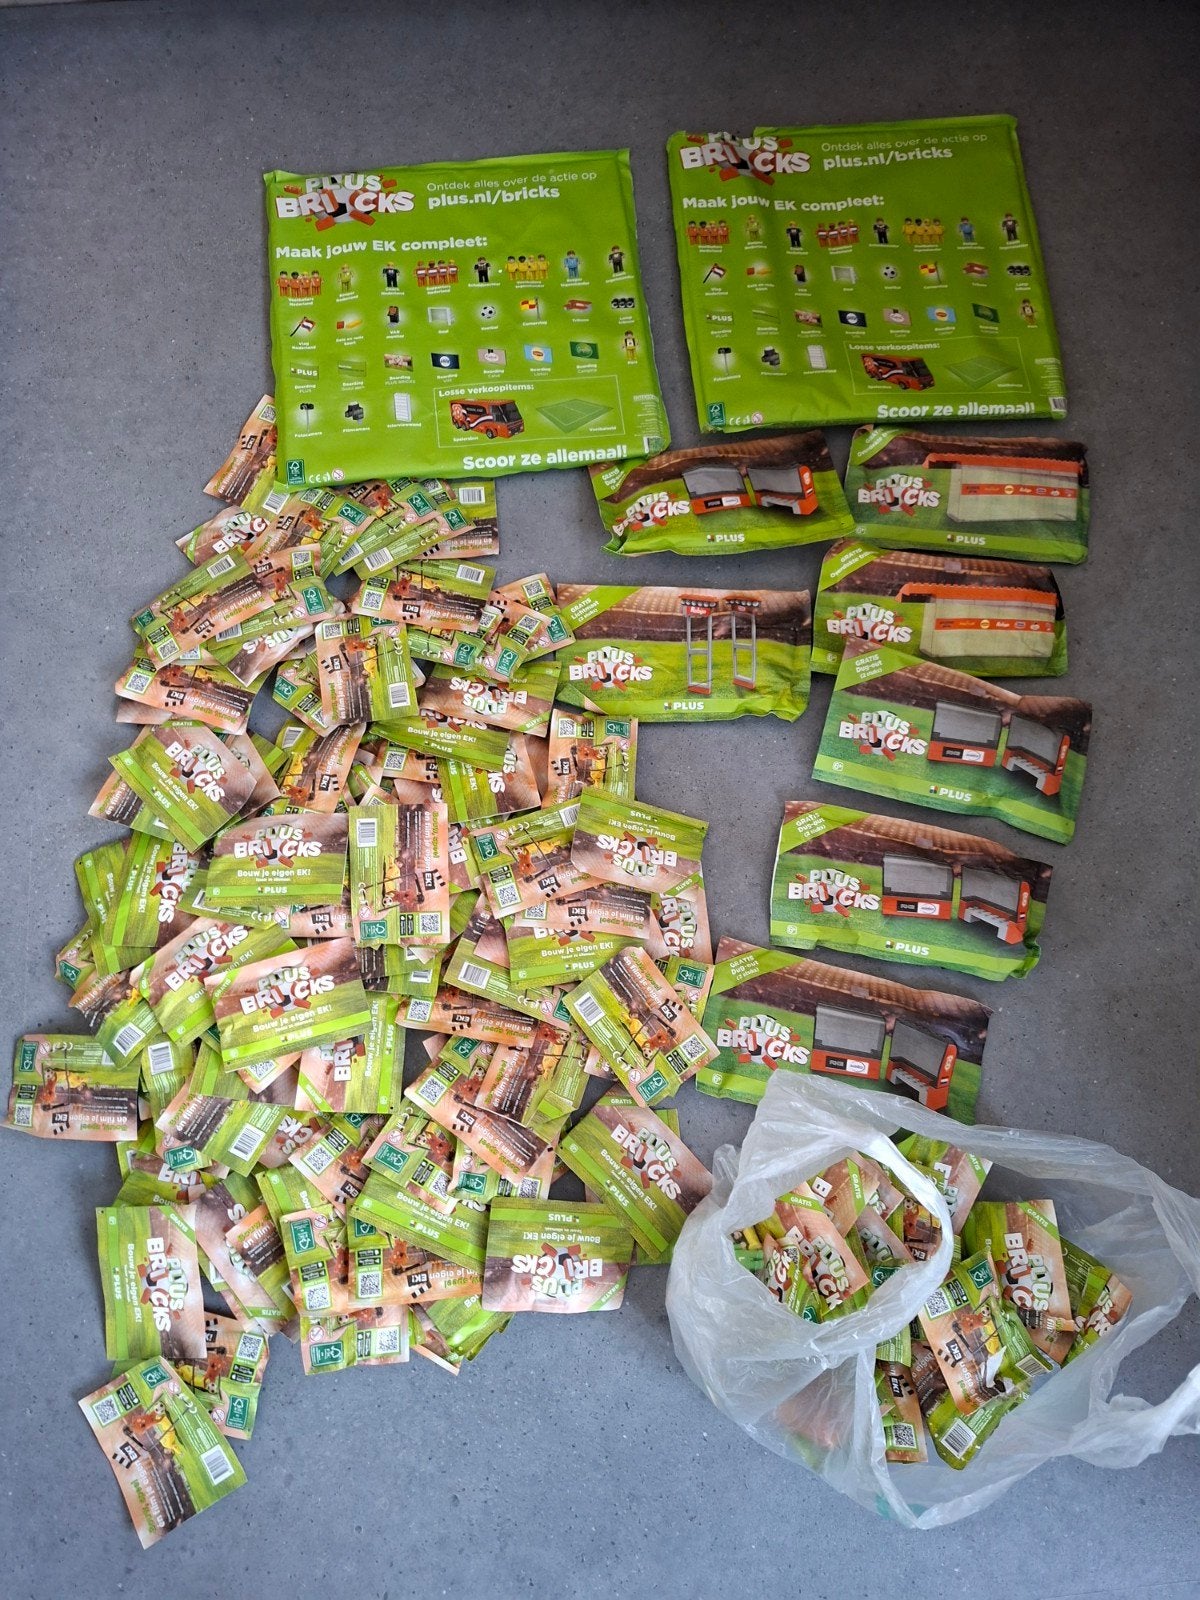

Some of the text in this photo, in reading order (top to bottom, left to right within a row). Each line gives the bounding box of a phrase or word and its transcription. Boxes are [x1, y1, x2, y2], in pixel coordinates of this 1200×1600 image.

[822, 134, 988, 152] Ontdek alles over de actie op
[680, 142, 810, 173] BRICKS
[823, 147, 953, 170] plus.nl/bricks
[306, 174, 382, 193] PLUS
[427, 172, 597, 192] Ontdek alles over de actie op
[276, 191, 416, 218] BRICKS
[428, 185, 560, 209] plus.nl/bricks
[683, 195, 885, 212] Maak jouw EK compleet:
[276, 236, 488, 259] Maak jouw EK compleet:
[849, 342, 940, 351] Losse verkoopitems:
[439, 383, 534, 396] Losse verkoopitems:
[877, 402, 1035, 418] Scoor ze allemaal!
[463, 445, 627, 470] Scoor ze allemaal!
[876, 476, 923, 489] PLUS
[858, 488, 941, 507] BRICKS
[716, 534, 744, 542] PLUS
[955, 535, 986, 545] PLUS
[841, 548, 862, 563] GRATIS
[570, 598, 591, 613] GRATIS
[571, 600, 600, 620] Lichtmast
[846, 606, 894, 624] PLUS
[827, 619, 913, 643] BRICKS
[588, 651, 634, 665] PLUS
[855, 654, 879, 665] GRATIS
[569, 661, 653, 681] BRICKS
[463, 694, 507, 714] PLUS
[673, 702, 704, 710] PLUS
[861, 712, 910, 734] PLUS
[839, 721, 928, 755] BRICKS
[163, 736, 226, 806] BRICKS
[189, 740, 228, 781] PLUS
[154, 789, 172, 809] PLUS
[939, 787, 972, 802] PLUS
[796, 812, 820, 826] GRATIS
[255, 825, 304, 840] PLUS
[234, 839, 322, 859] BRICKS
[594, 833, 679, 868] BRICKS
[262, 870, 272, 878] je
[274, 869, 294, 878] eigen
[610, 853, 657, 878] PLUS
[156, 841, 189, 924] BRICKS
[810, 870, 860, 891] PLUS
[788, 881, 881, 911] BRICKS
[571, 906, 586, 914] EK!
[678, 901, 697, 948] PLUS
[175, 926, 221, 962] PLUS
[896, 942, 929, 956] PLUS
[165, 926, 249, 992] BRICKS
[730, 955, 754, 969] GRATIS
[257, 966, 311, 991] PLUS
[240, 975, 335, 1015] BRICKS
[384, 1023, 394, 1048] PLUS
[739, 1017, 790, 1041] PLUS
[717, 1028, 810, 1065] BRICKS
[634, 1124, 681, 1172] PLUS
[608, 1121, 685, 1202] BRICKS
[599, 1148, 658, 1210] Bouw je eigen EK!
[852, 1173, 862, 1200] GRATIS
[608, 1184, 630, 1207] PLUS
[790, 1196, 812, 1207] GRATIS
[1026, 1208, 1048, 1228] GRATIS
[414, 1222, 440, 1238] PLUS
[523, 1232, 600, 1243] Bouw je eigen EK!
[510, 1253, 602, 1279] BRICKS
[811, 1236, 849, 1294] PLUS
[1004, 1232, 1032, 1310] BRIC
[146, 1236, 171, 1332] BRICKS
[166, 1257, 186, 1310] PLUS
[530, 1275, 582, 1293] PLUS
[1031, 1254, 1049, 1311] PLUS
